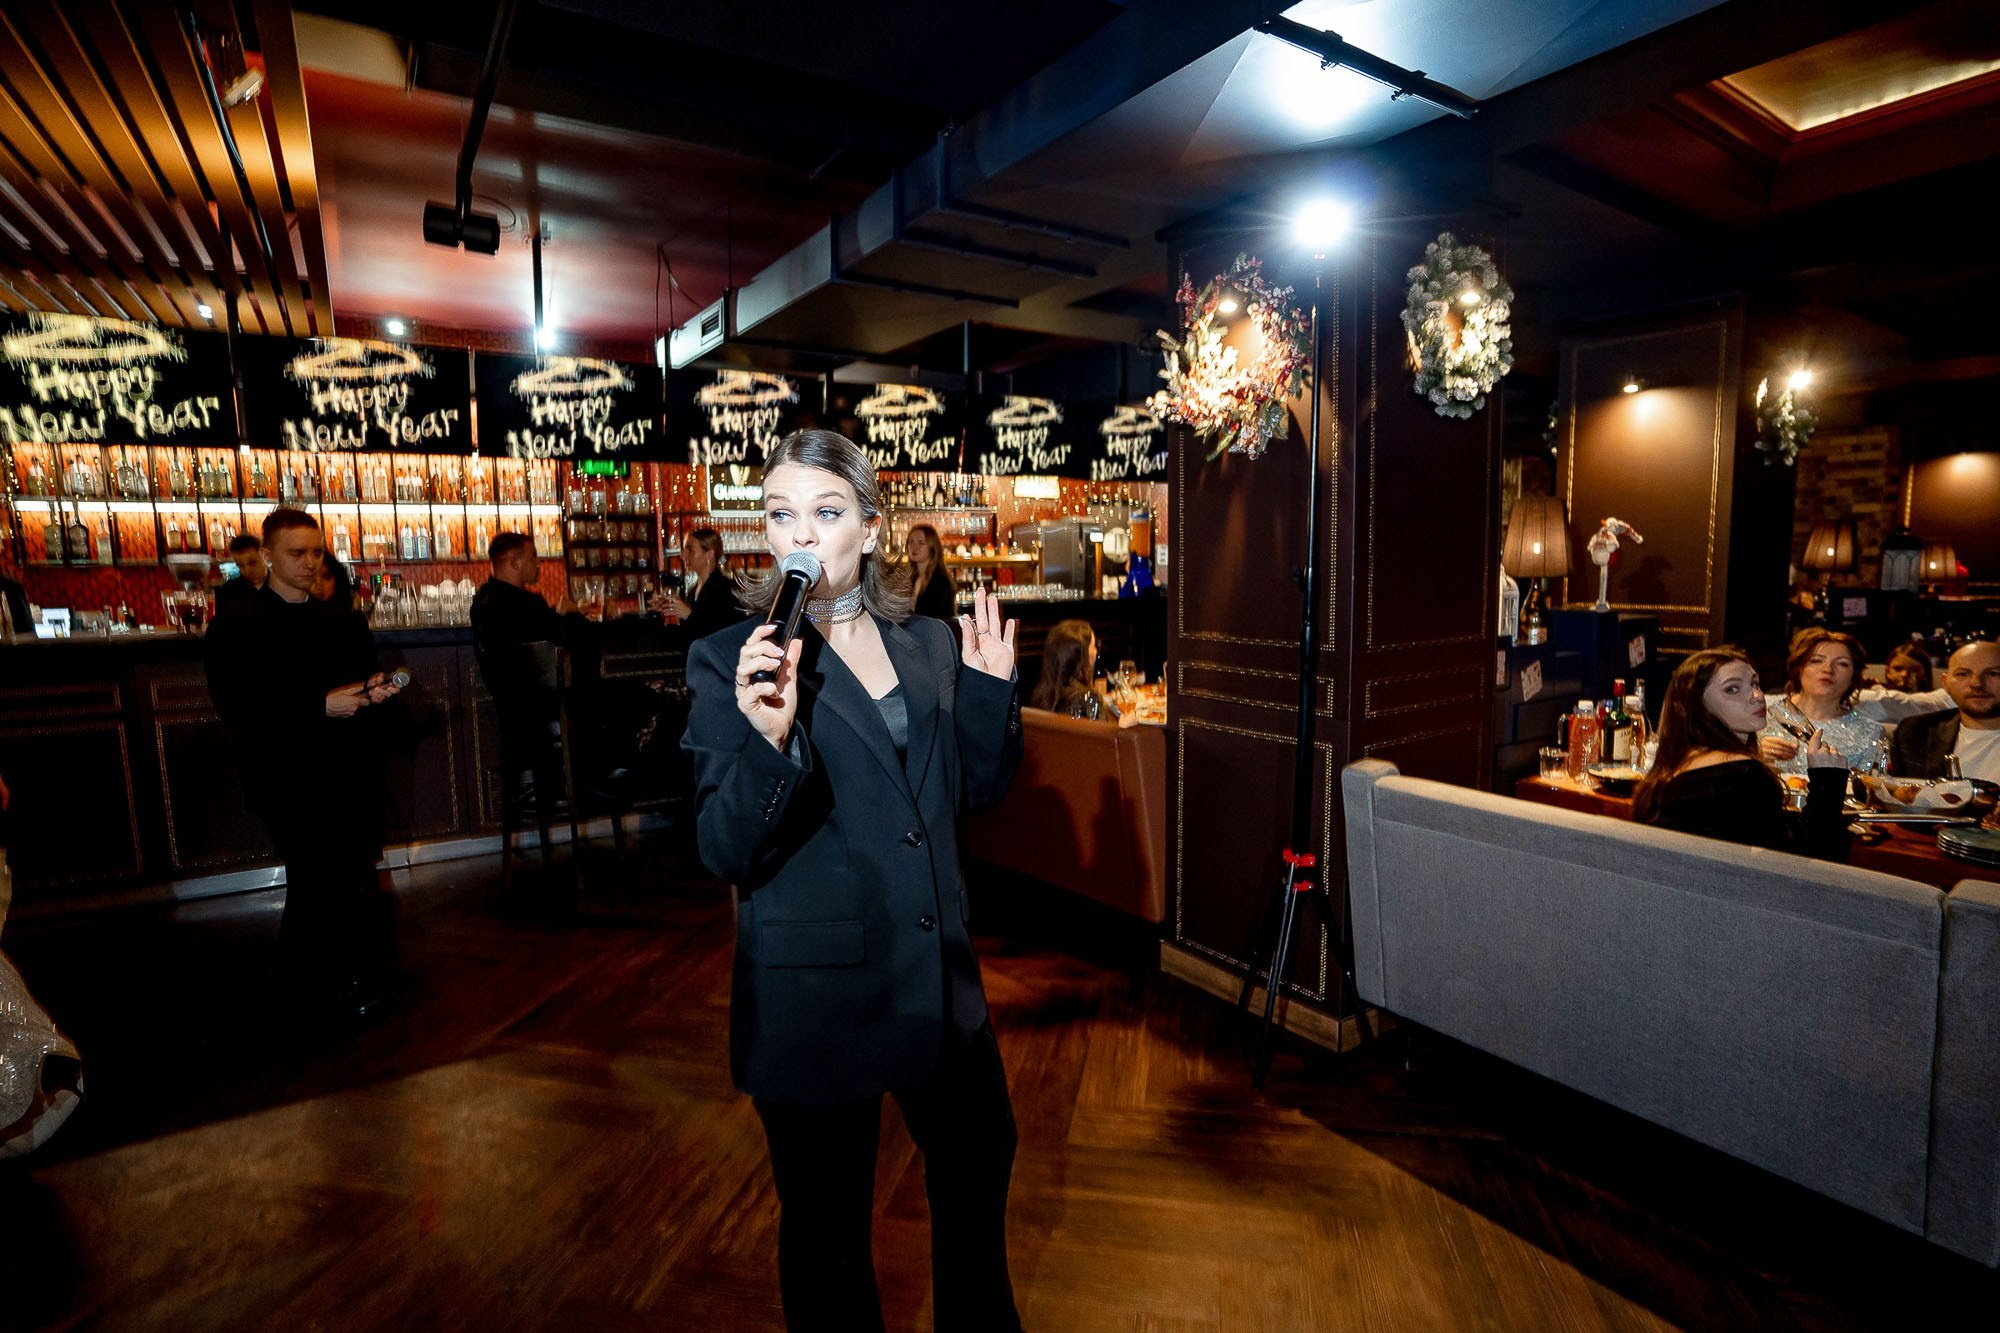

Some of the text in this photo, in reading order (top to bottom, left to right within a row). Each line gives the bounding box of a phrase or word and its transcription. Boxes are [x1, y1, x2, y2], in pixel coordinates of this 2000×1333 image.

[31, 362, 154, 409] Happy
[311, 380, 409, 421] Happy
[0, 396, 219, 443] New Year
[282, 408, 459, 452] New Year
[531, 395, 613, 431] Happy
[710, 405, 780, 439] Happy
[506, 419, 653, 459] New Year
[867, 416, 928, 447] Happy
[997, 426, 1048, 454] Happy
[1107, 434, 1152, 460] Happy
[689, 436, 748, 466] New
[861, 436, 955, 470] ew Year
[980, 444, 1072, 475] New Year
[1091, 458, 1130, 481] New
